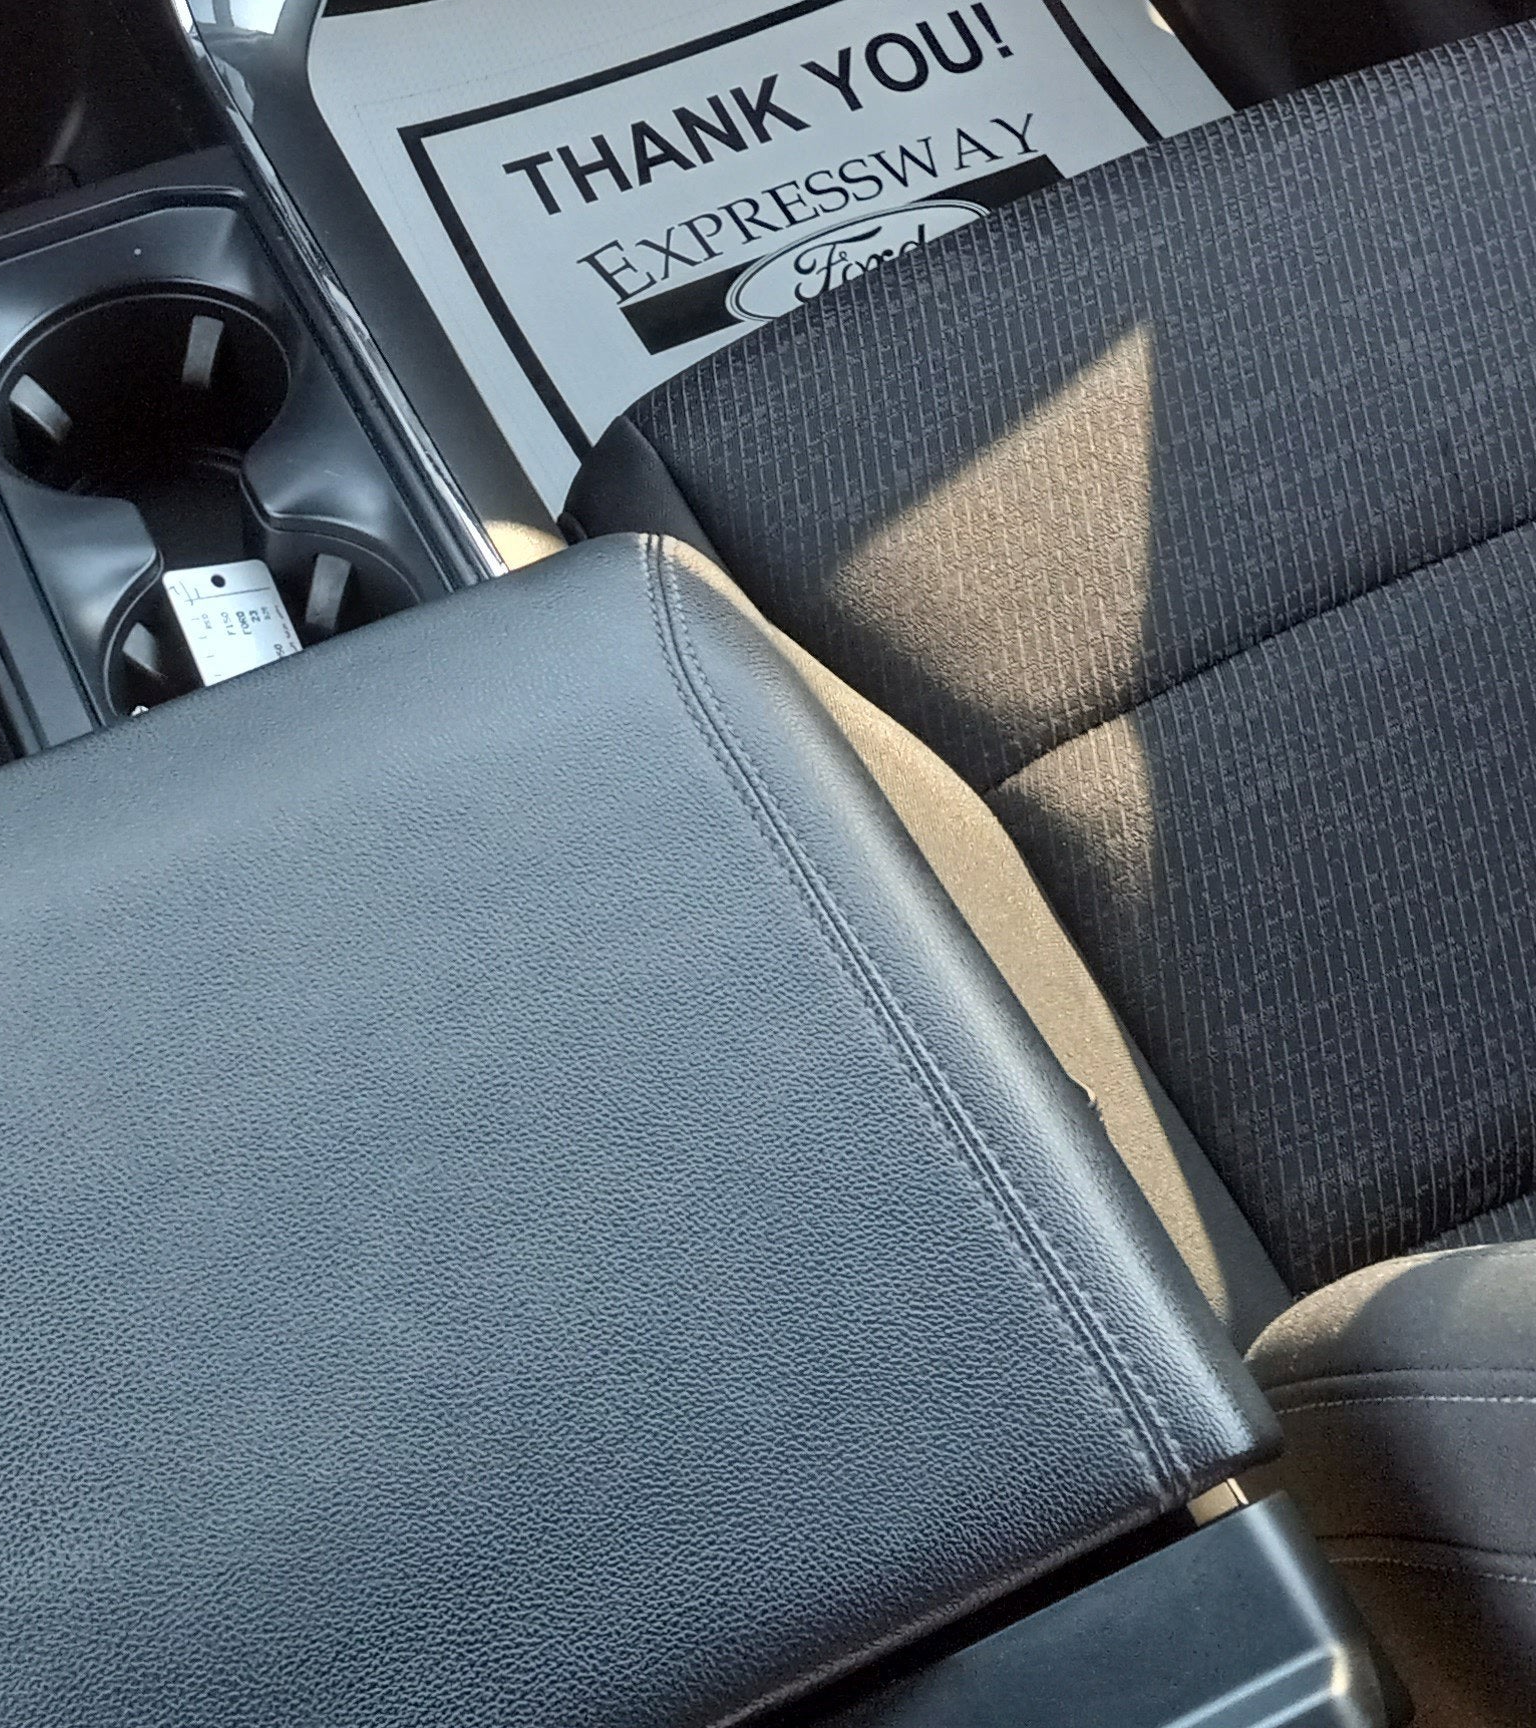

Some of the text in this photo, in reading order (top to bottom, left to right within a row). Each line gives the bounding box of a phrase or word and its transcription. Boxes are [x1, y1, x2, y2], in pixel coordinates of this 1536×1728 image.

[503, 2, 1015, 217] THANK YOU!
[576, 112, 1039, 307] EXPRESSWAY
